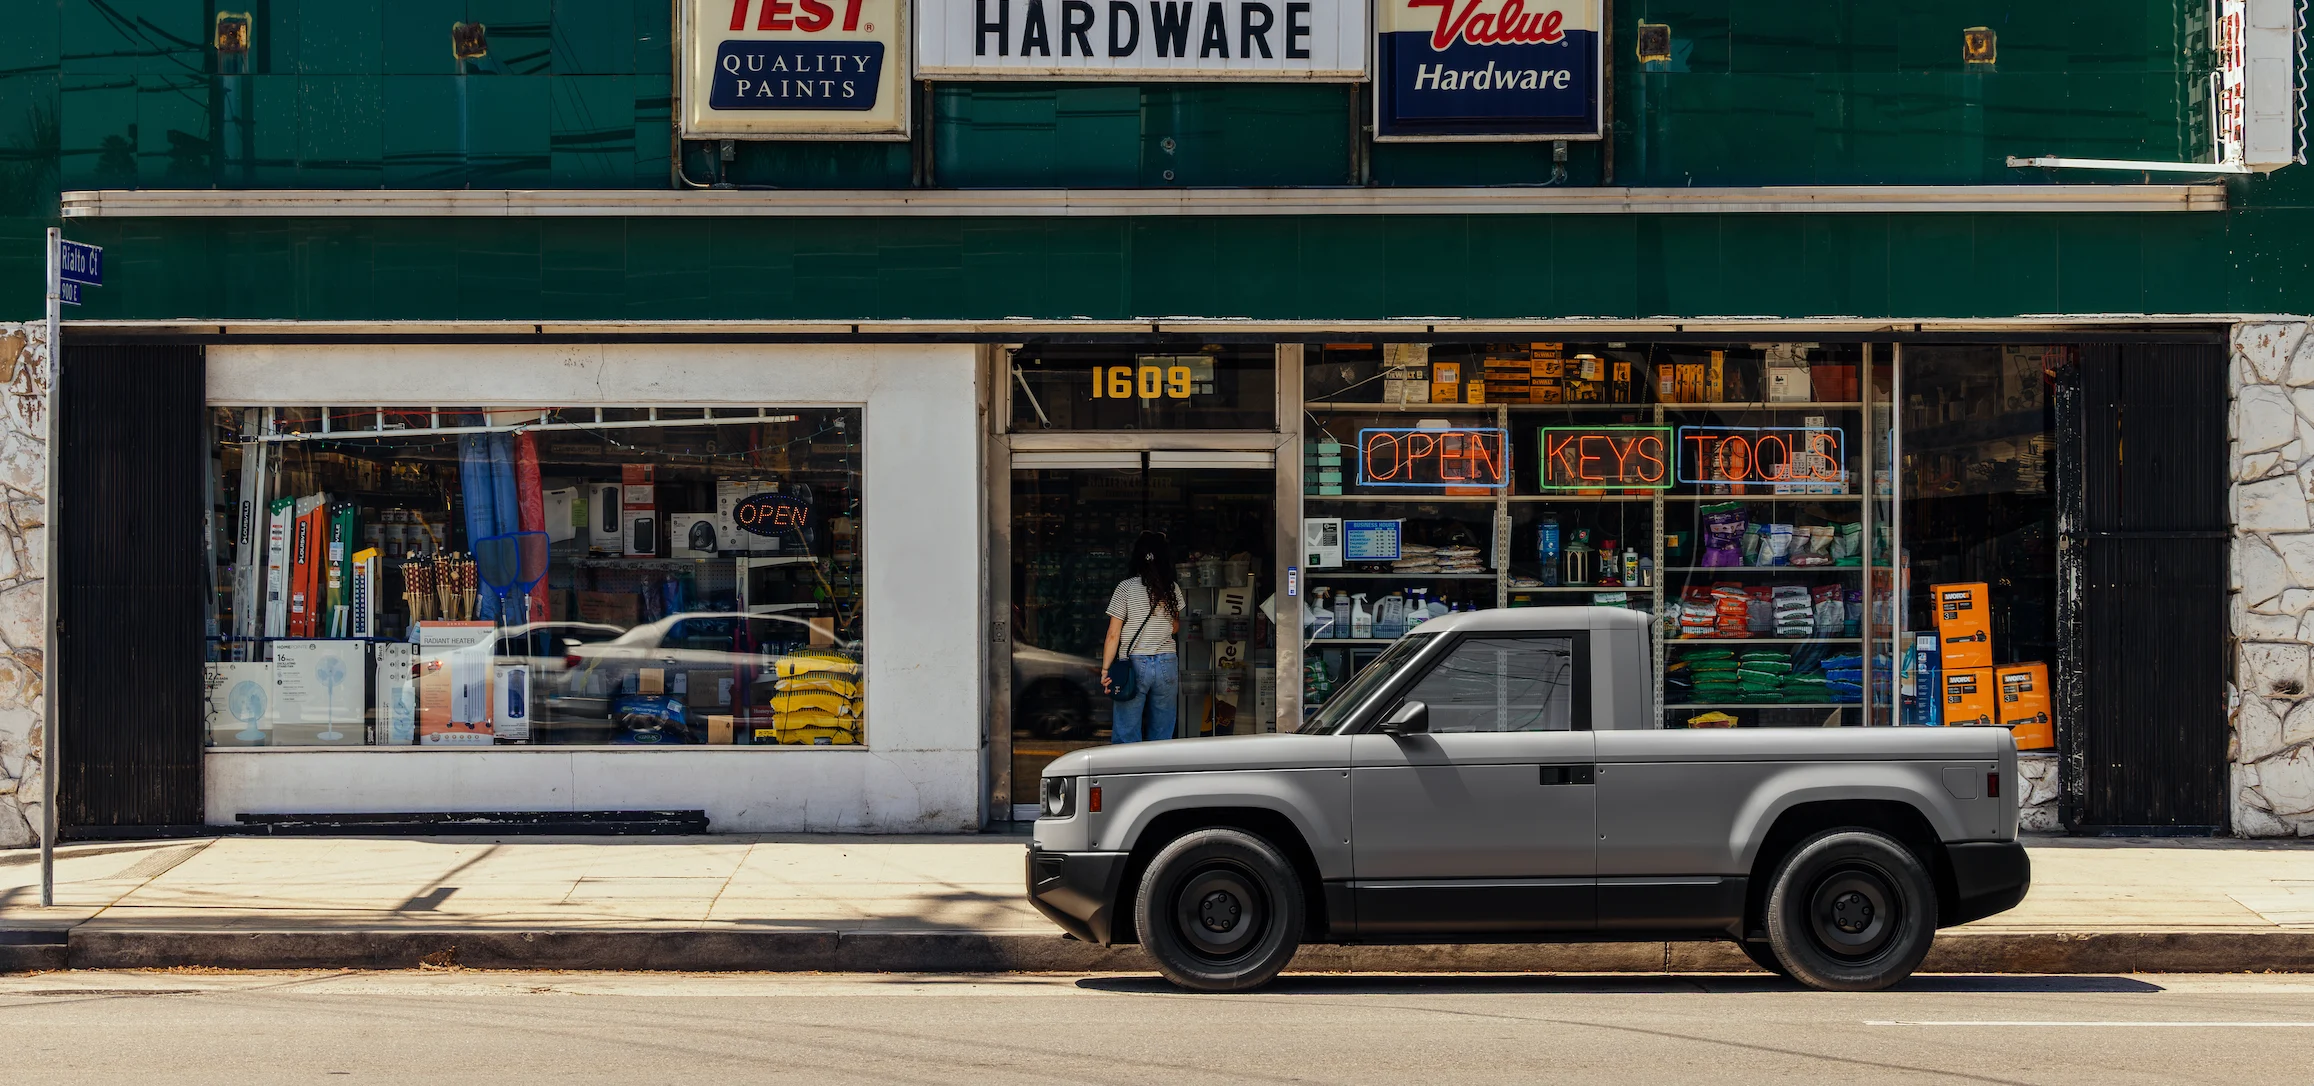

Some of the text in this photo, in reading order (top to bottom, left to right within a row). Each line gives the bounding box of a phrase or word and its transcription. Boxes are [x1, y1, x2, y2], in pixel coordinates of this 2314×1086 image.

[729, 0, 862, 33] TEST
[975, 0, 1310, 59] HARDWARE
[1407, 0, 1563, 49] Value
[722, 54, 872, 76] QUALITY
[1414, 60, 1571, 91] Hardware
[736, 79, 856, 99] PAINTS
[62, 245, 97, 276] Rialto Ct
[61, 282, 77, 302] 900 E
[1092, 365, 1192, 399] 1609
[1367, 433, 1502, 481] OPEN
[1548, 433, 1664, 482] KEYS
[1684, 433, 1838, 481] TOOLS
[739, 503, 809, 526] OPEN
[299, 522, 307, 559] LOUISVILLE
[1944, 612, 1950, 620] 3
[277, 654, 286, 662] 16
